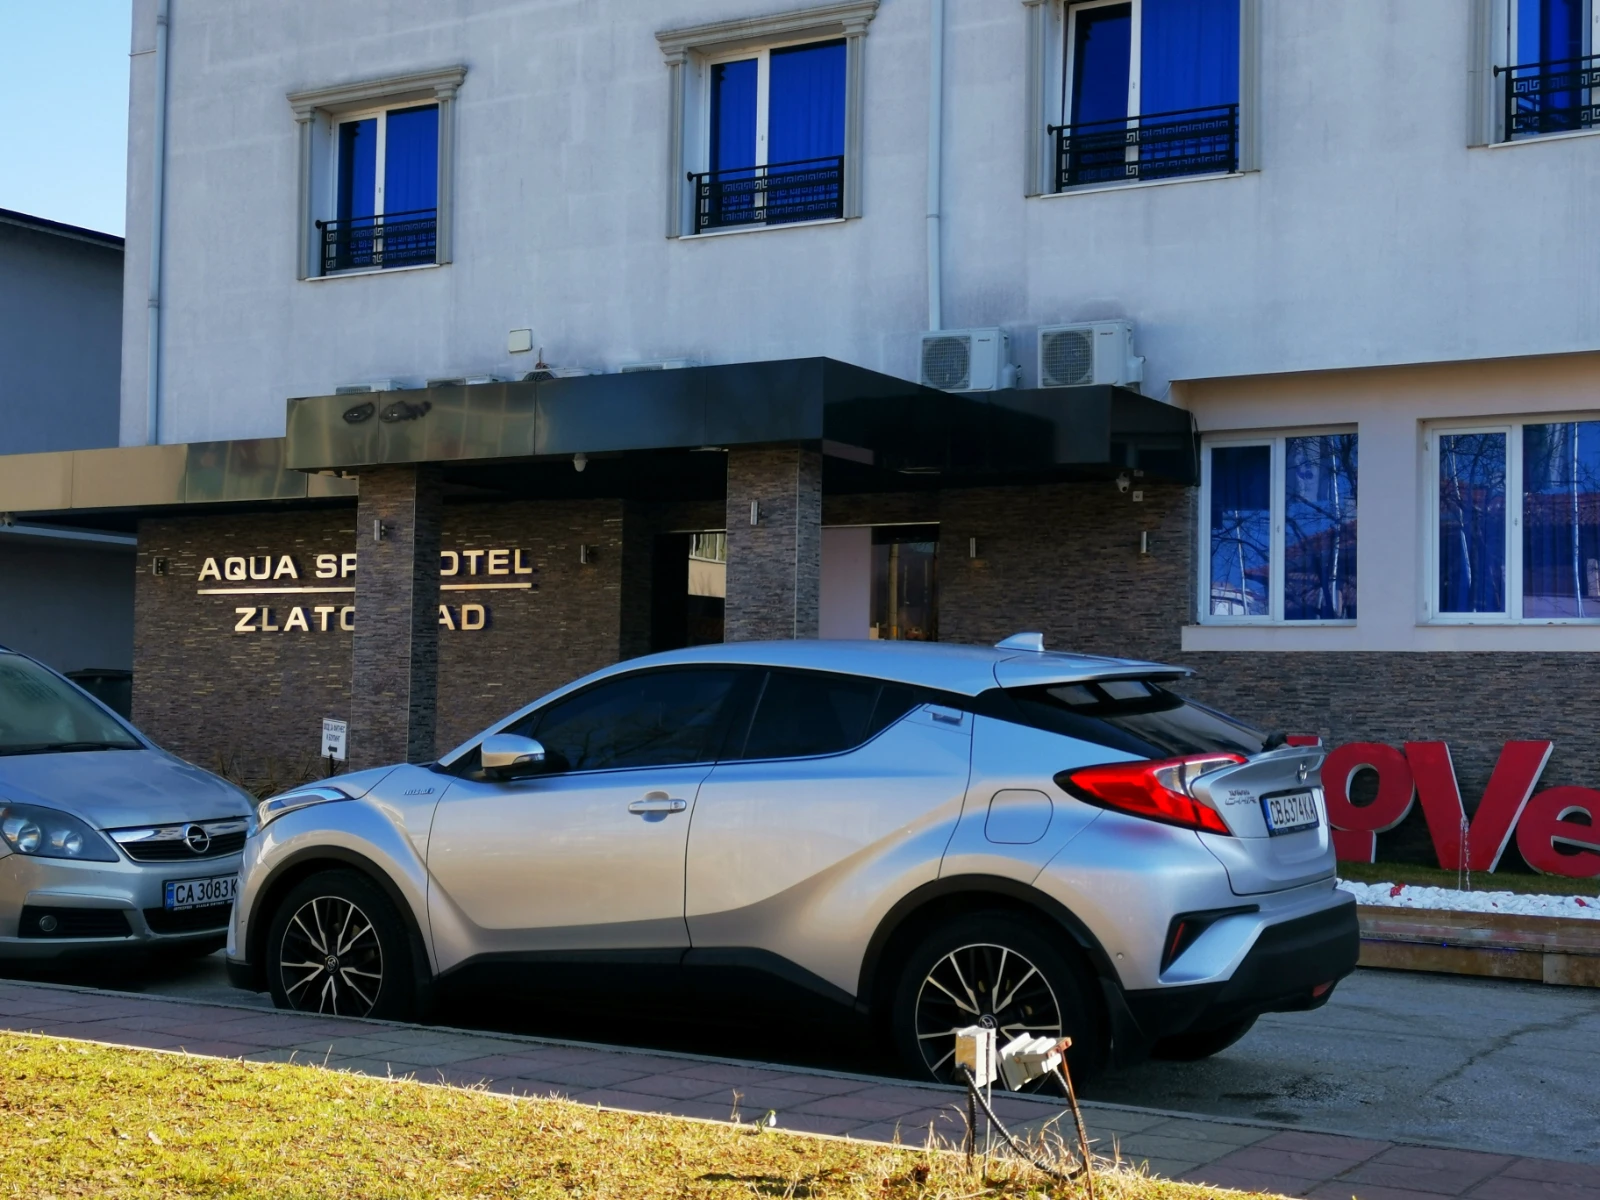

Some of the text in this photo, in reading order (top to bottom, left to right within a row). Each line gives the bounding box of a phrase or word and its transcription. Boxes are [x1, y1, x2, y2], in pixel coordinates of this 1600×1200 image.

[198, 549, 533, 581] AQUA SP OTEL
[197, 880, 228, 901] 3083
[231, 878, 238, 897] K
